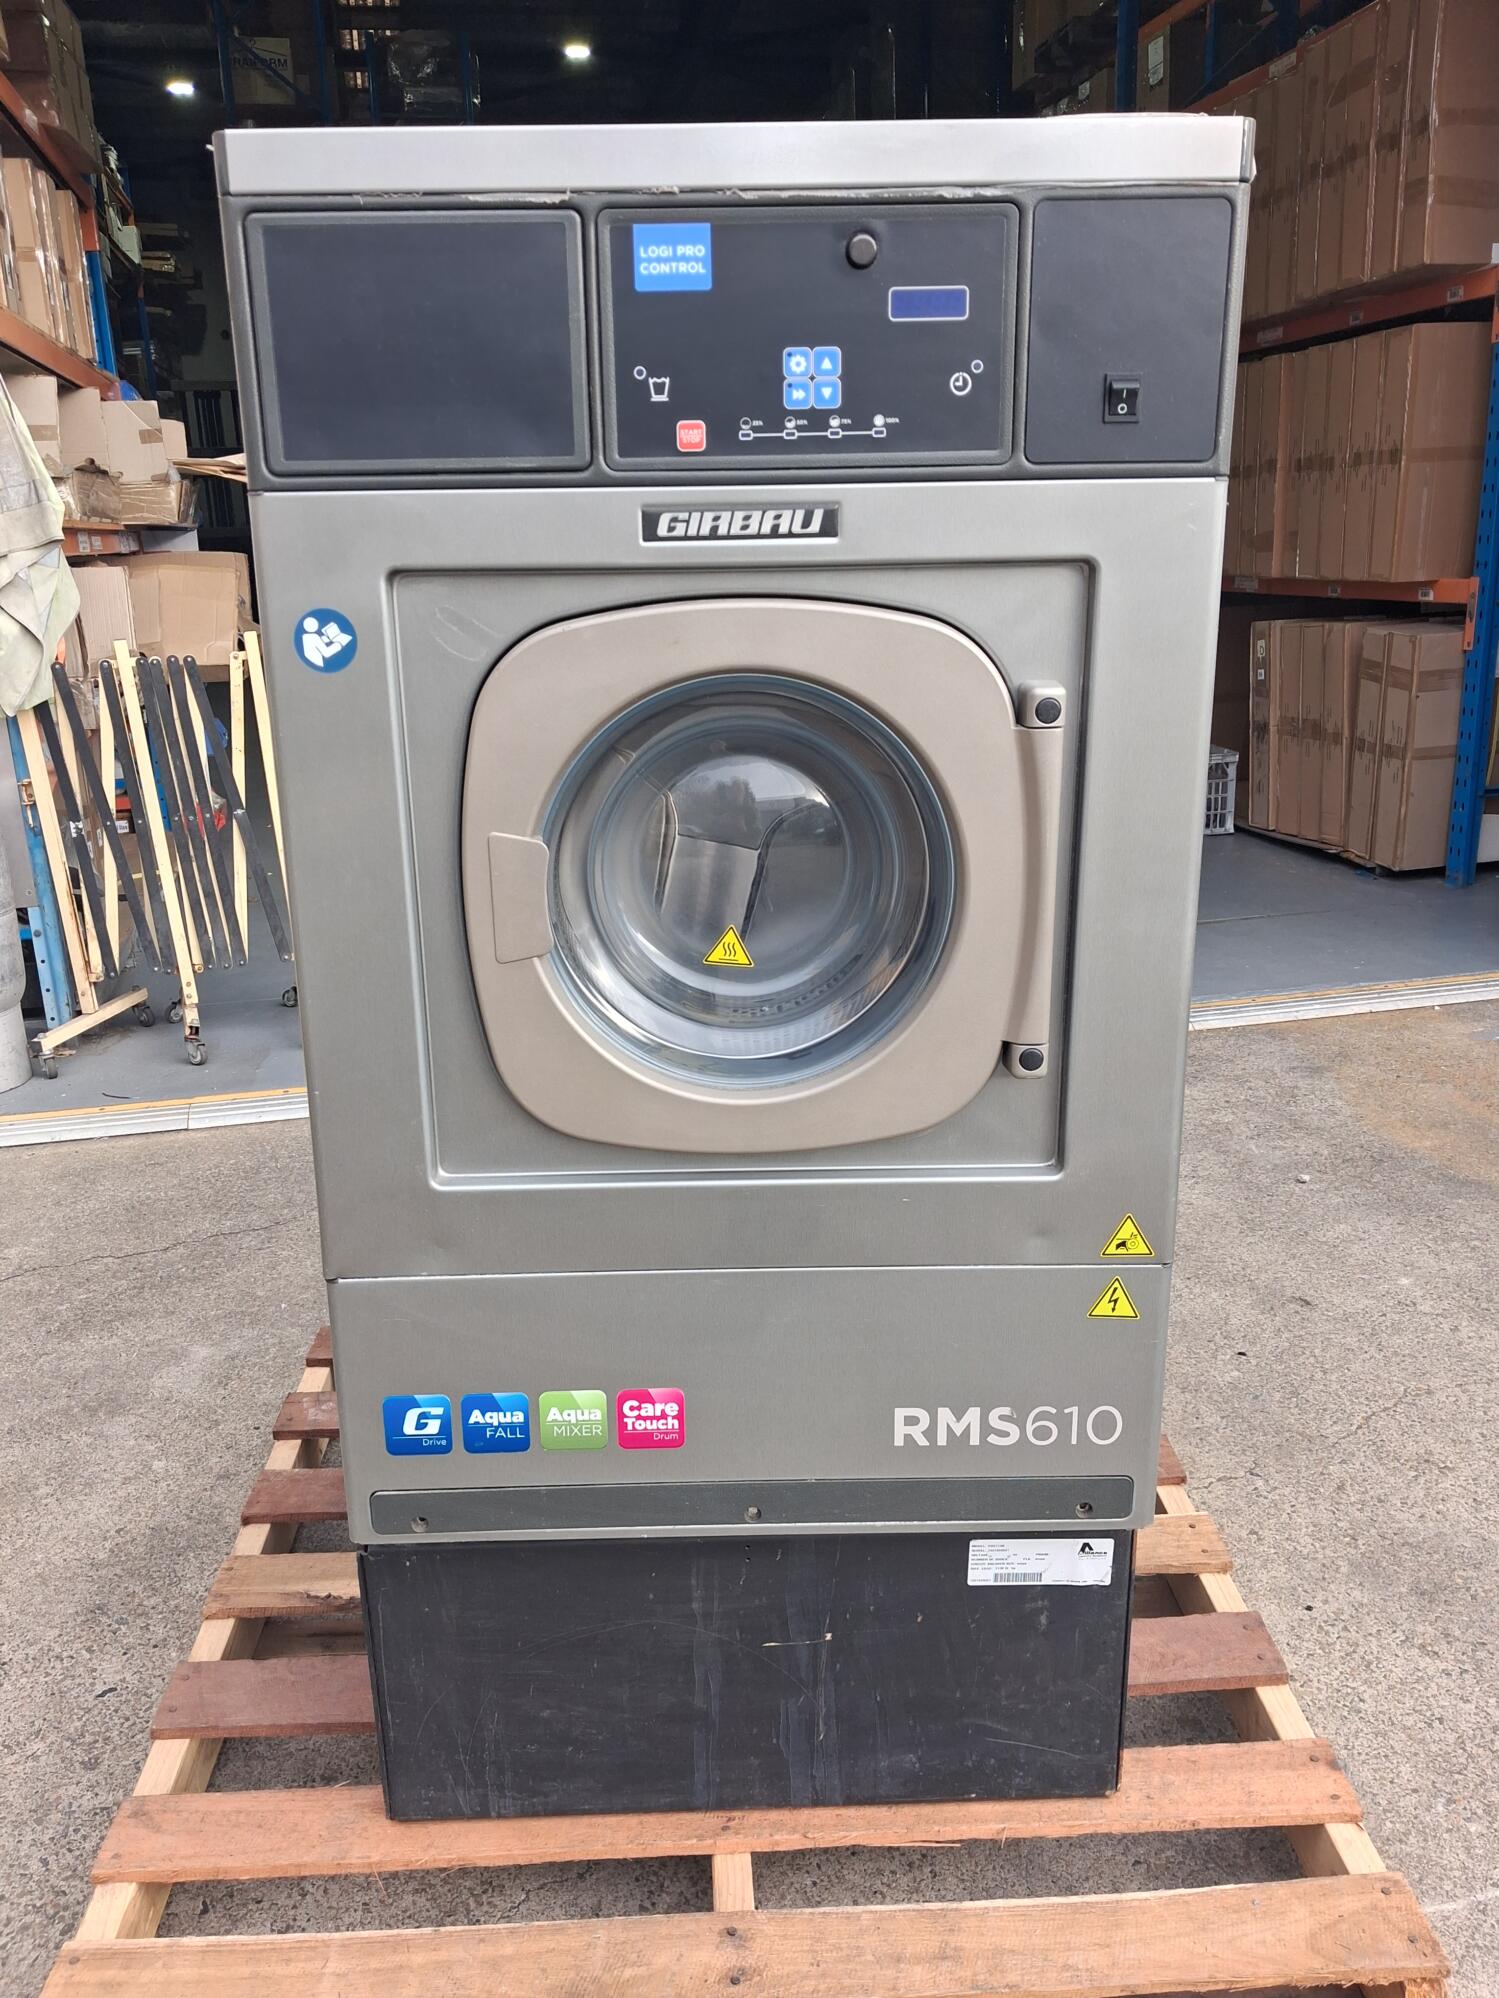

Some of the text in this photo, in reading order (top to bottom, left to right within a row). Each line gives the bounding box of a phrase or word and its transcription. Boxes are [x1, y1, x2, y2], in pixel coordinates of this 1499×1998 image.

[640, 244, 705, 258] LOGI PRO
[640, 261, 706, 275] CONTROL
[679, 428, 703, 437] START
[683, 436, 701, 444] STOP
[656, 508, 824, 537] GIRBAU
[546, 1406, 601, 1424] Aqua
[622, 1399, 679, 1417] Care
[402, 1406, 444, 1435] G
[468, 1408, 525, 1425] Aqua
[624, 1416, 679, 1430] Touch
[486, 1427, 525, 1438] FALL
[553, 1425, 602, 1436] MIXER
[893, 1405, 1123, 1447] RMS610
[422, 1437, 447, 1446] Drive
[653, 1432, 679, 1441] Drum
